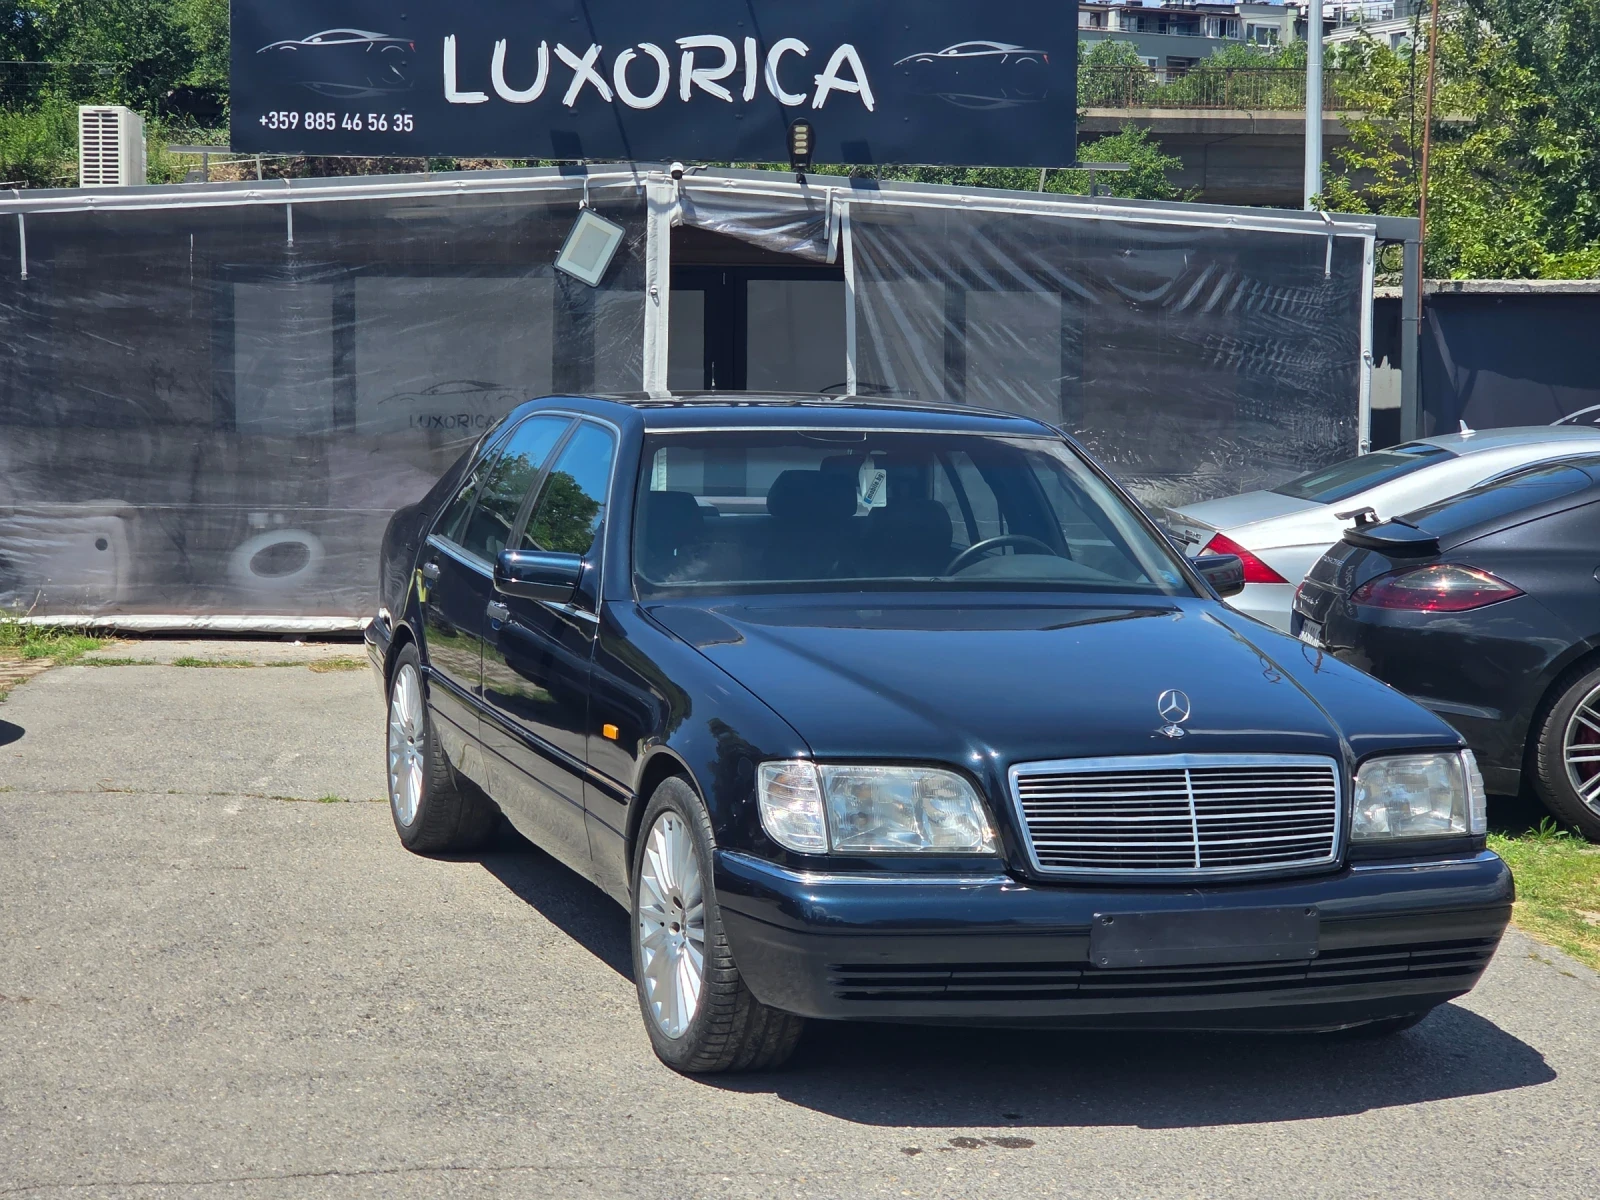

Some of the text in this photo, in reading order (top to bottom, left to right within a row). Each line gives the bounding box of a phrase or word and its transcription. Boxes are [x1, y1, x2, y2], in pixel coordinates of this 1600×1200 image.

[443, 33, 876, 112] LUXORICA
[259, 111, 414, 132] +359 885 46 56 35
